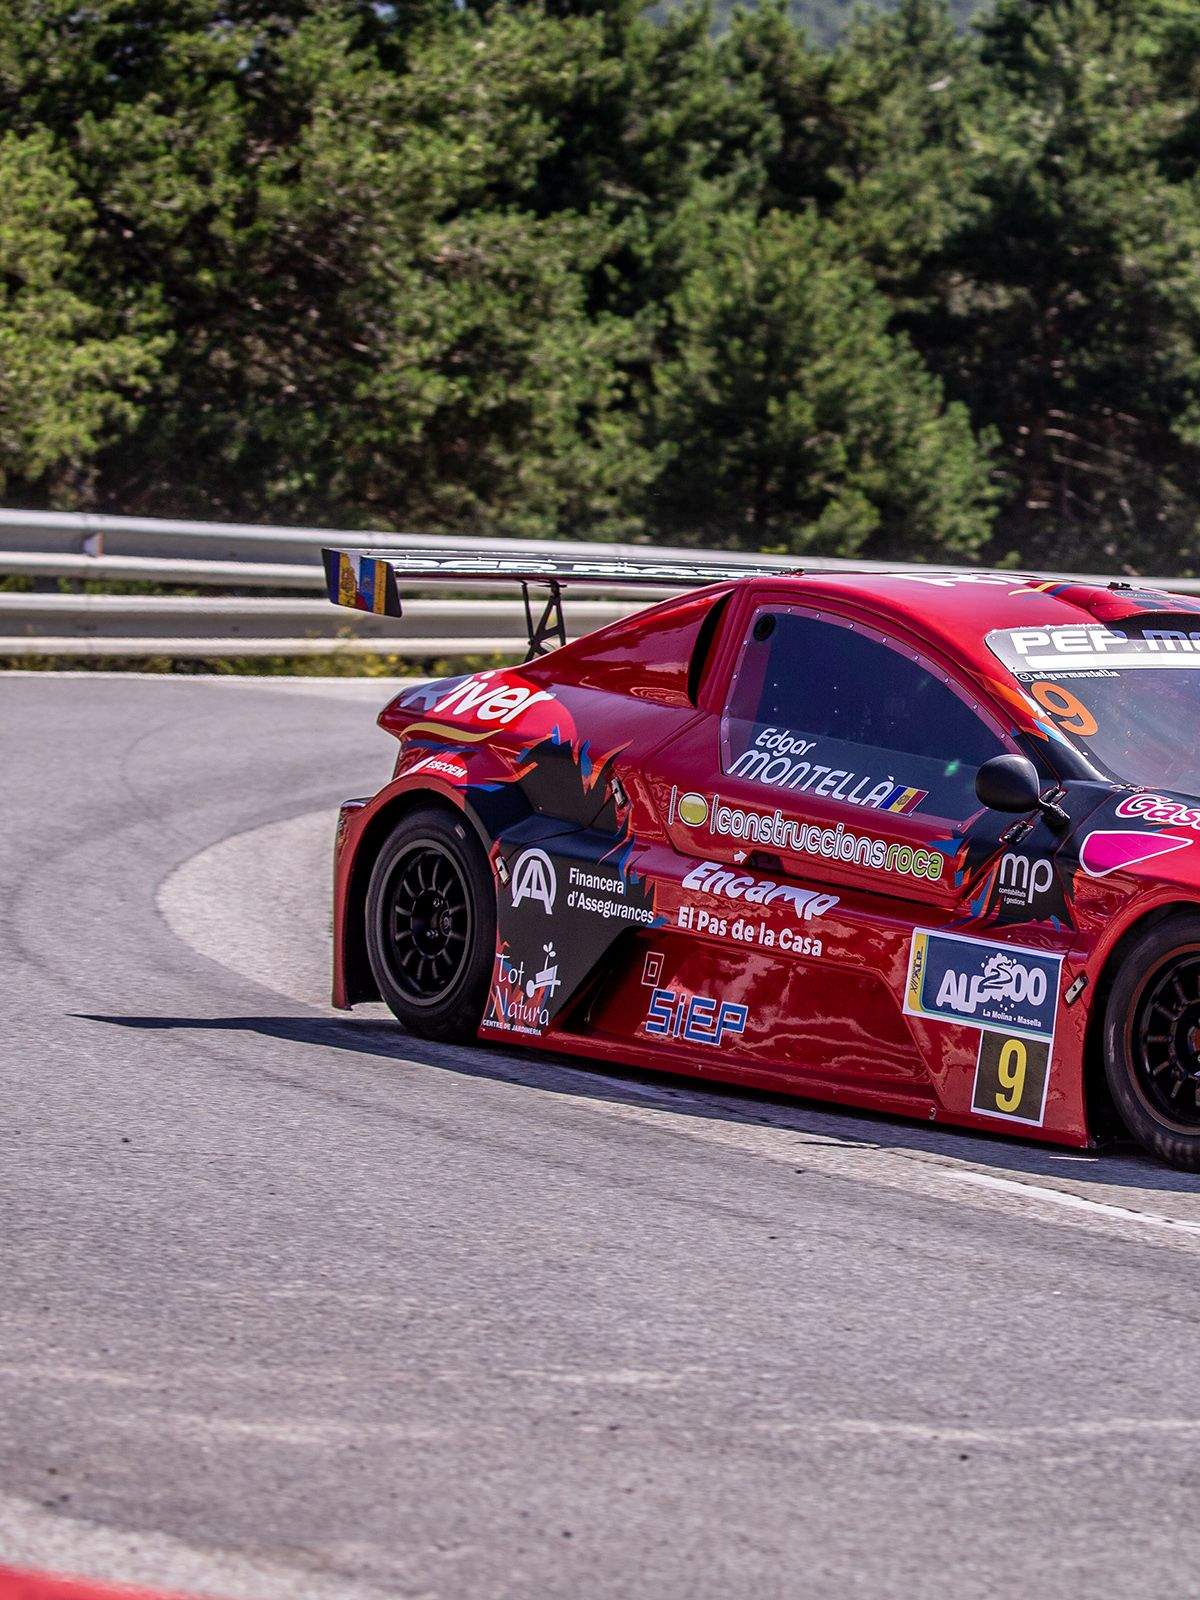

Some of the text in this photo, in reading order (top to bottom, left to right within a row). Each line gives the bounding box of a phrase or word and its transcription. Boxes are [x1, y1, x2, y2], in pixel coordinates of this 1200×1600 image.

[1008, 629, 1128, 654] PEP
[400, 671, 557, 724] River
[1030, 681, 1098, 737] 9
[755, 728, 817, 757] Edgar
[569, 867, 624, 894] Financera
[682, 861, 841, 920] Encamp
[999, 853, 1053, 903] mp
[567, 892, 654, 924] d'Assegurances
[677, 906, 823, 957] El Pas de la Casa
[490, 985, 549, 1026] Natura
[982, 1008, 1042, 1028] La Molina Masella
[996, 1039, 1027, 1112] 9
